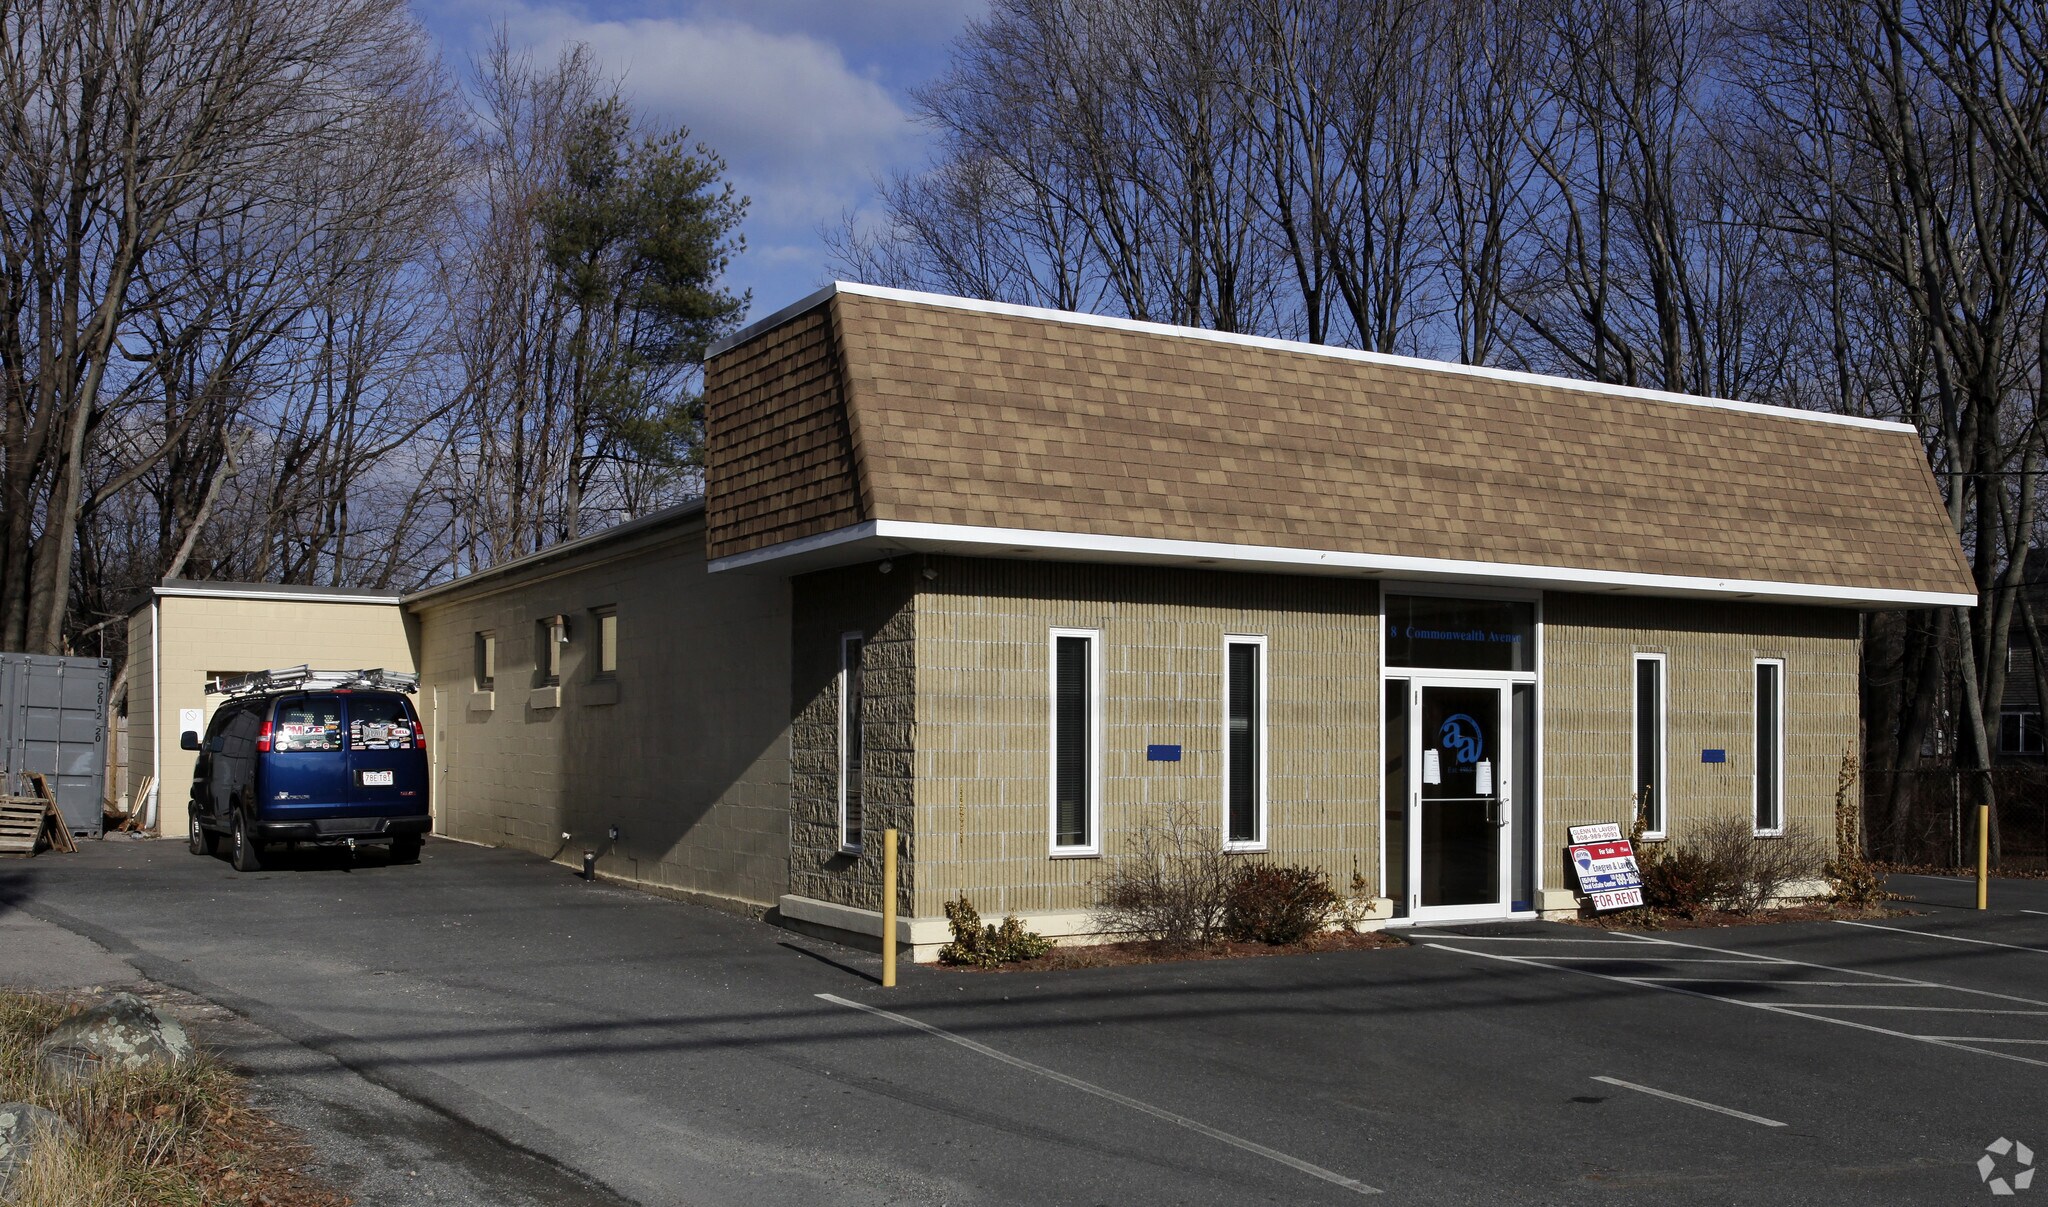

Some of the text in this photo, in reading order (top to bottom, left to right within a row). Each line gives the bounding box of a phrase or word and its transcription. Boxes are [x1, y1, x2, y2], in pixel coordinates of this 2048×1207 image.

[1390, 625, 1522, 643] 8 Commonwealth Avenue
[1572, 828, 1591, 836] GLENN
[1598, 825, 1617, 833] LAVERY
[1592, 863, 1612, 873] Enegren
[1612, 862, 1618, 870] &
[1593, 890, 1640, 908] FOR RENT
